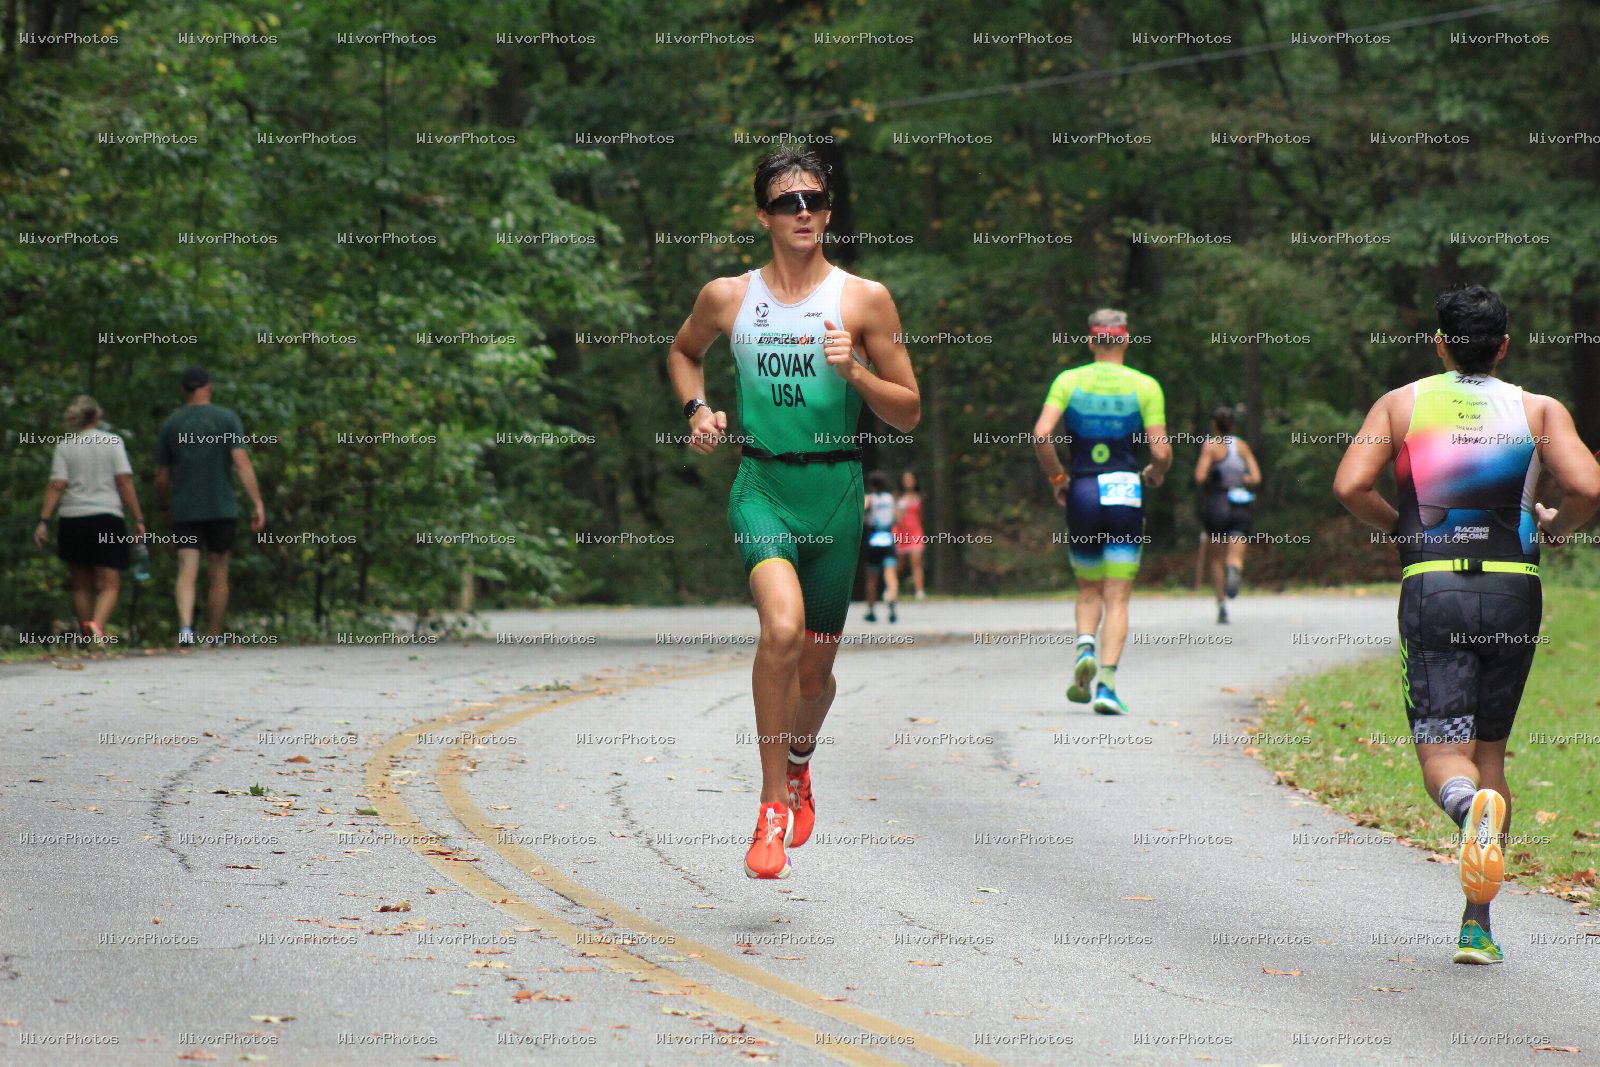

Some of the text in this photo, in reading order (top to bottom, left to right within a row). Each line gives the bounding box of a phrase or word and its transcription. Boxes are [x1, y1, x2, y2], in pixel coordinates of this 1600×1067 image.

[757, 353, 816, 377] KOVAK
[771, 383, 807, 407] USA
[1454, 525, 1490, 533] RACING
